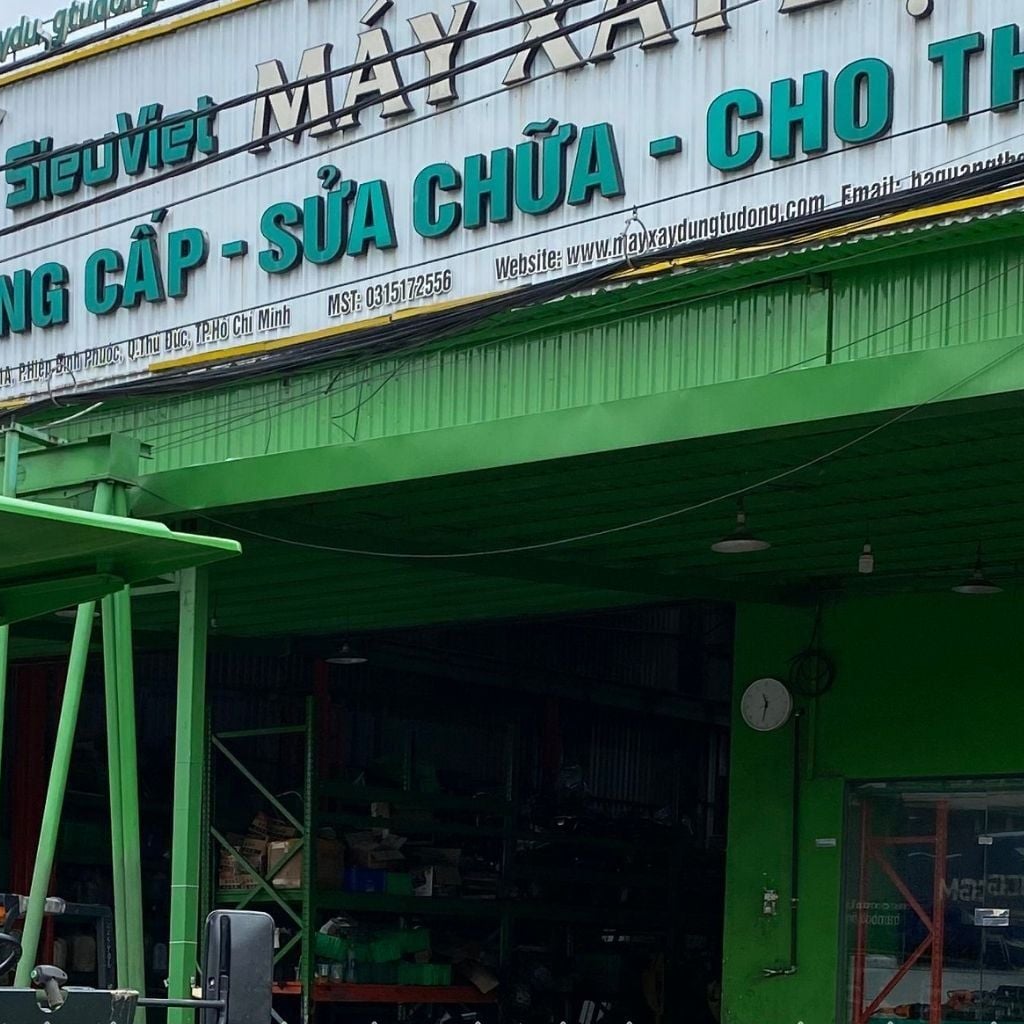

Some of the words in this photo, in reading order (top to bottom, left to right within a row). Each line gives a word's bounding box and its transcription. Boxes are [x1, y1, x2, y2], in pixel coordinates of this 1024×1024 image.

[84, 207, 208, 315] CẤP
[258, 164, 398, 274] SỬA
[412, 117, 626, 238] CHỮA
[706, 57, 893, 172] CHO
[495, 249, 562, 280] Website:
[567, 193, 825, 264] www.mayxaydungtudong.com
[258, 304, 291, 331] Minh
[328, 289, 361, 316] MST:
[366, 269, 452, 308] 0315172556
